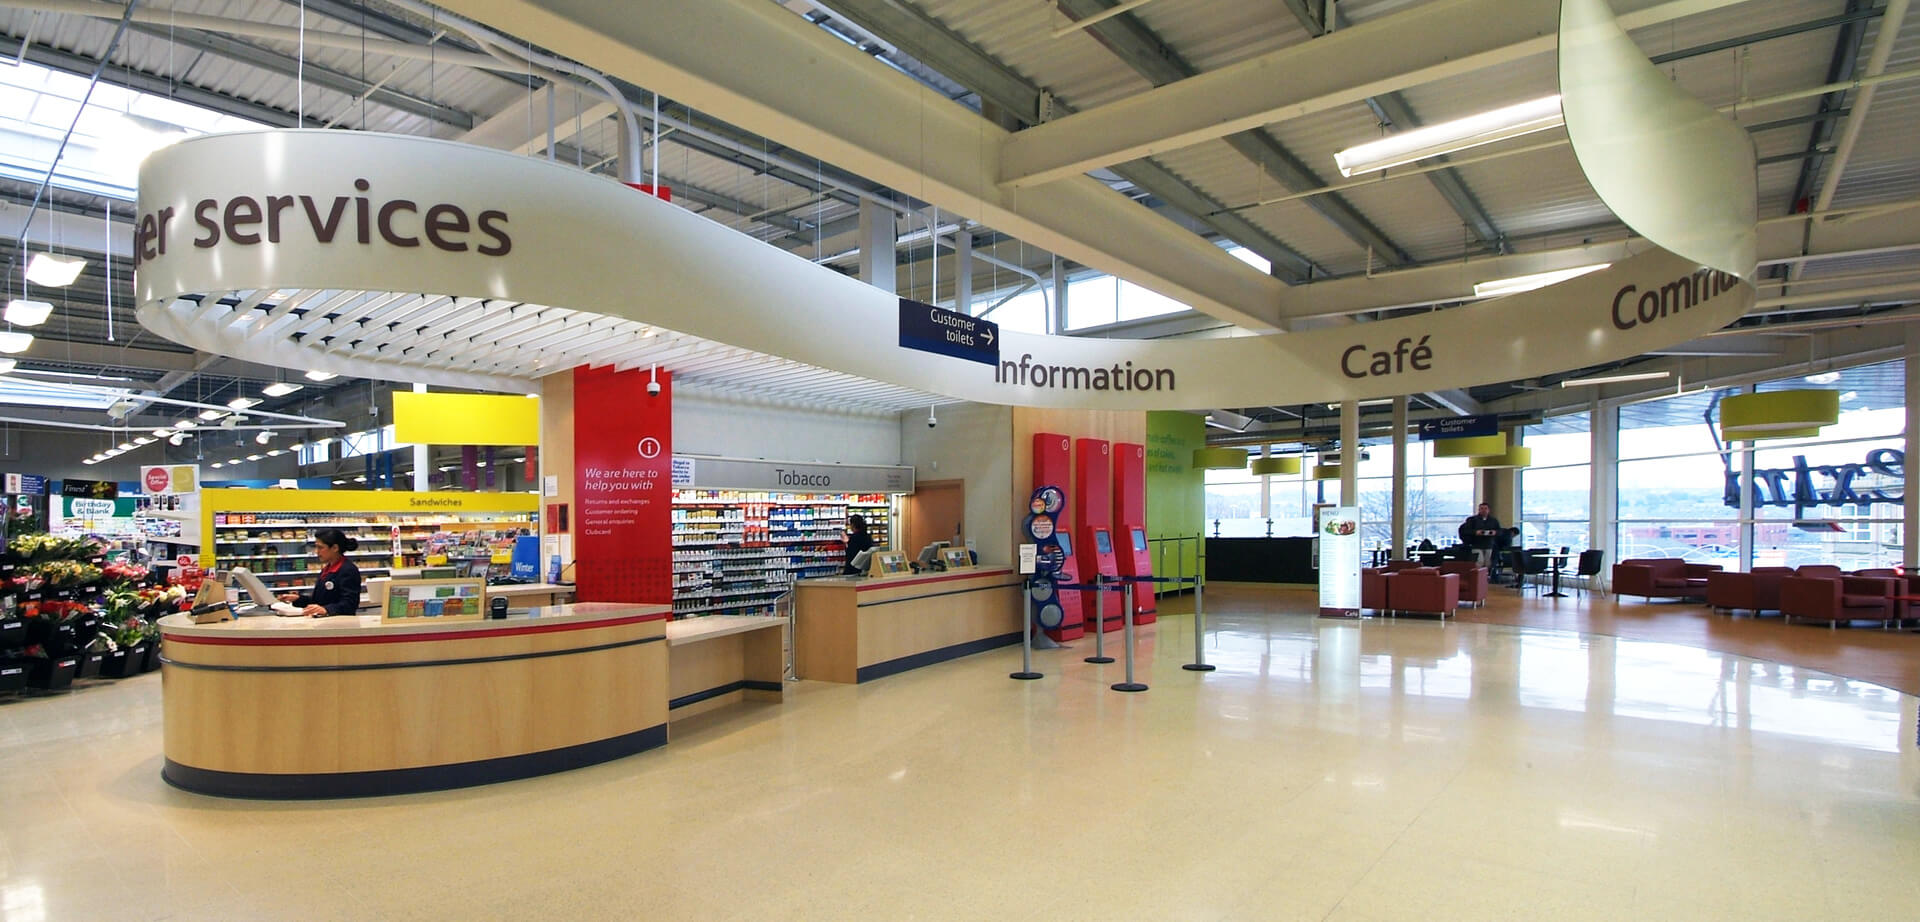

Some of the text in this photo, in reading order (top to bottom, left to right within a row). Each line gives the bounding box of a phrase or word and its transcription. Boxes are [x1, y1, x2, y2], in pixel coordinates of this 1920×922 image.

[135, 178, 513, 265] er services
[930, 308, 976, 331] Customer
[945, 329, 975, 347] toilets
[1341, 335, 1433, 379] Café
[1440, 418, 1476, 426] Customer
[585, 468, 658, 478] We are here to
[776, 469, 831, 487] Tobacco
[585, 480, 653, 492] help you with
[75, 499, 111, 509] Birthday
[410, 498, 462, 507] Sandwiches
[515, 561, 534, 573] Winter
